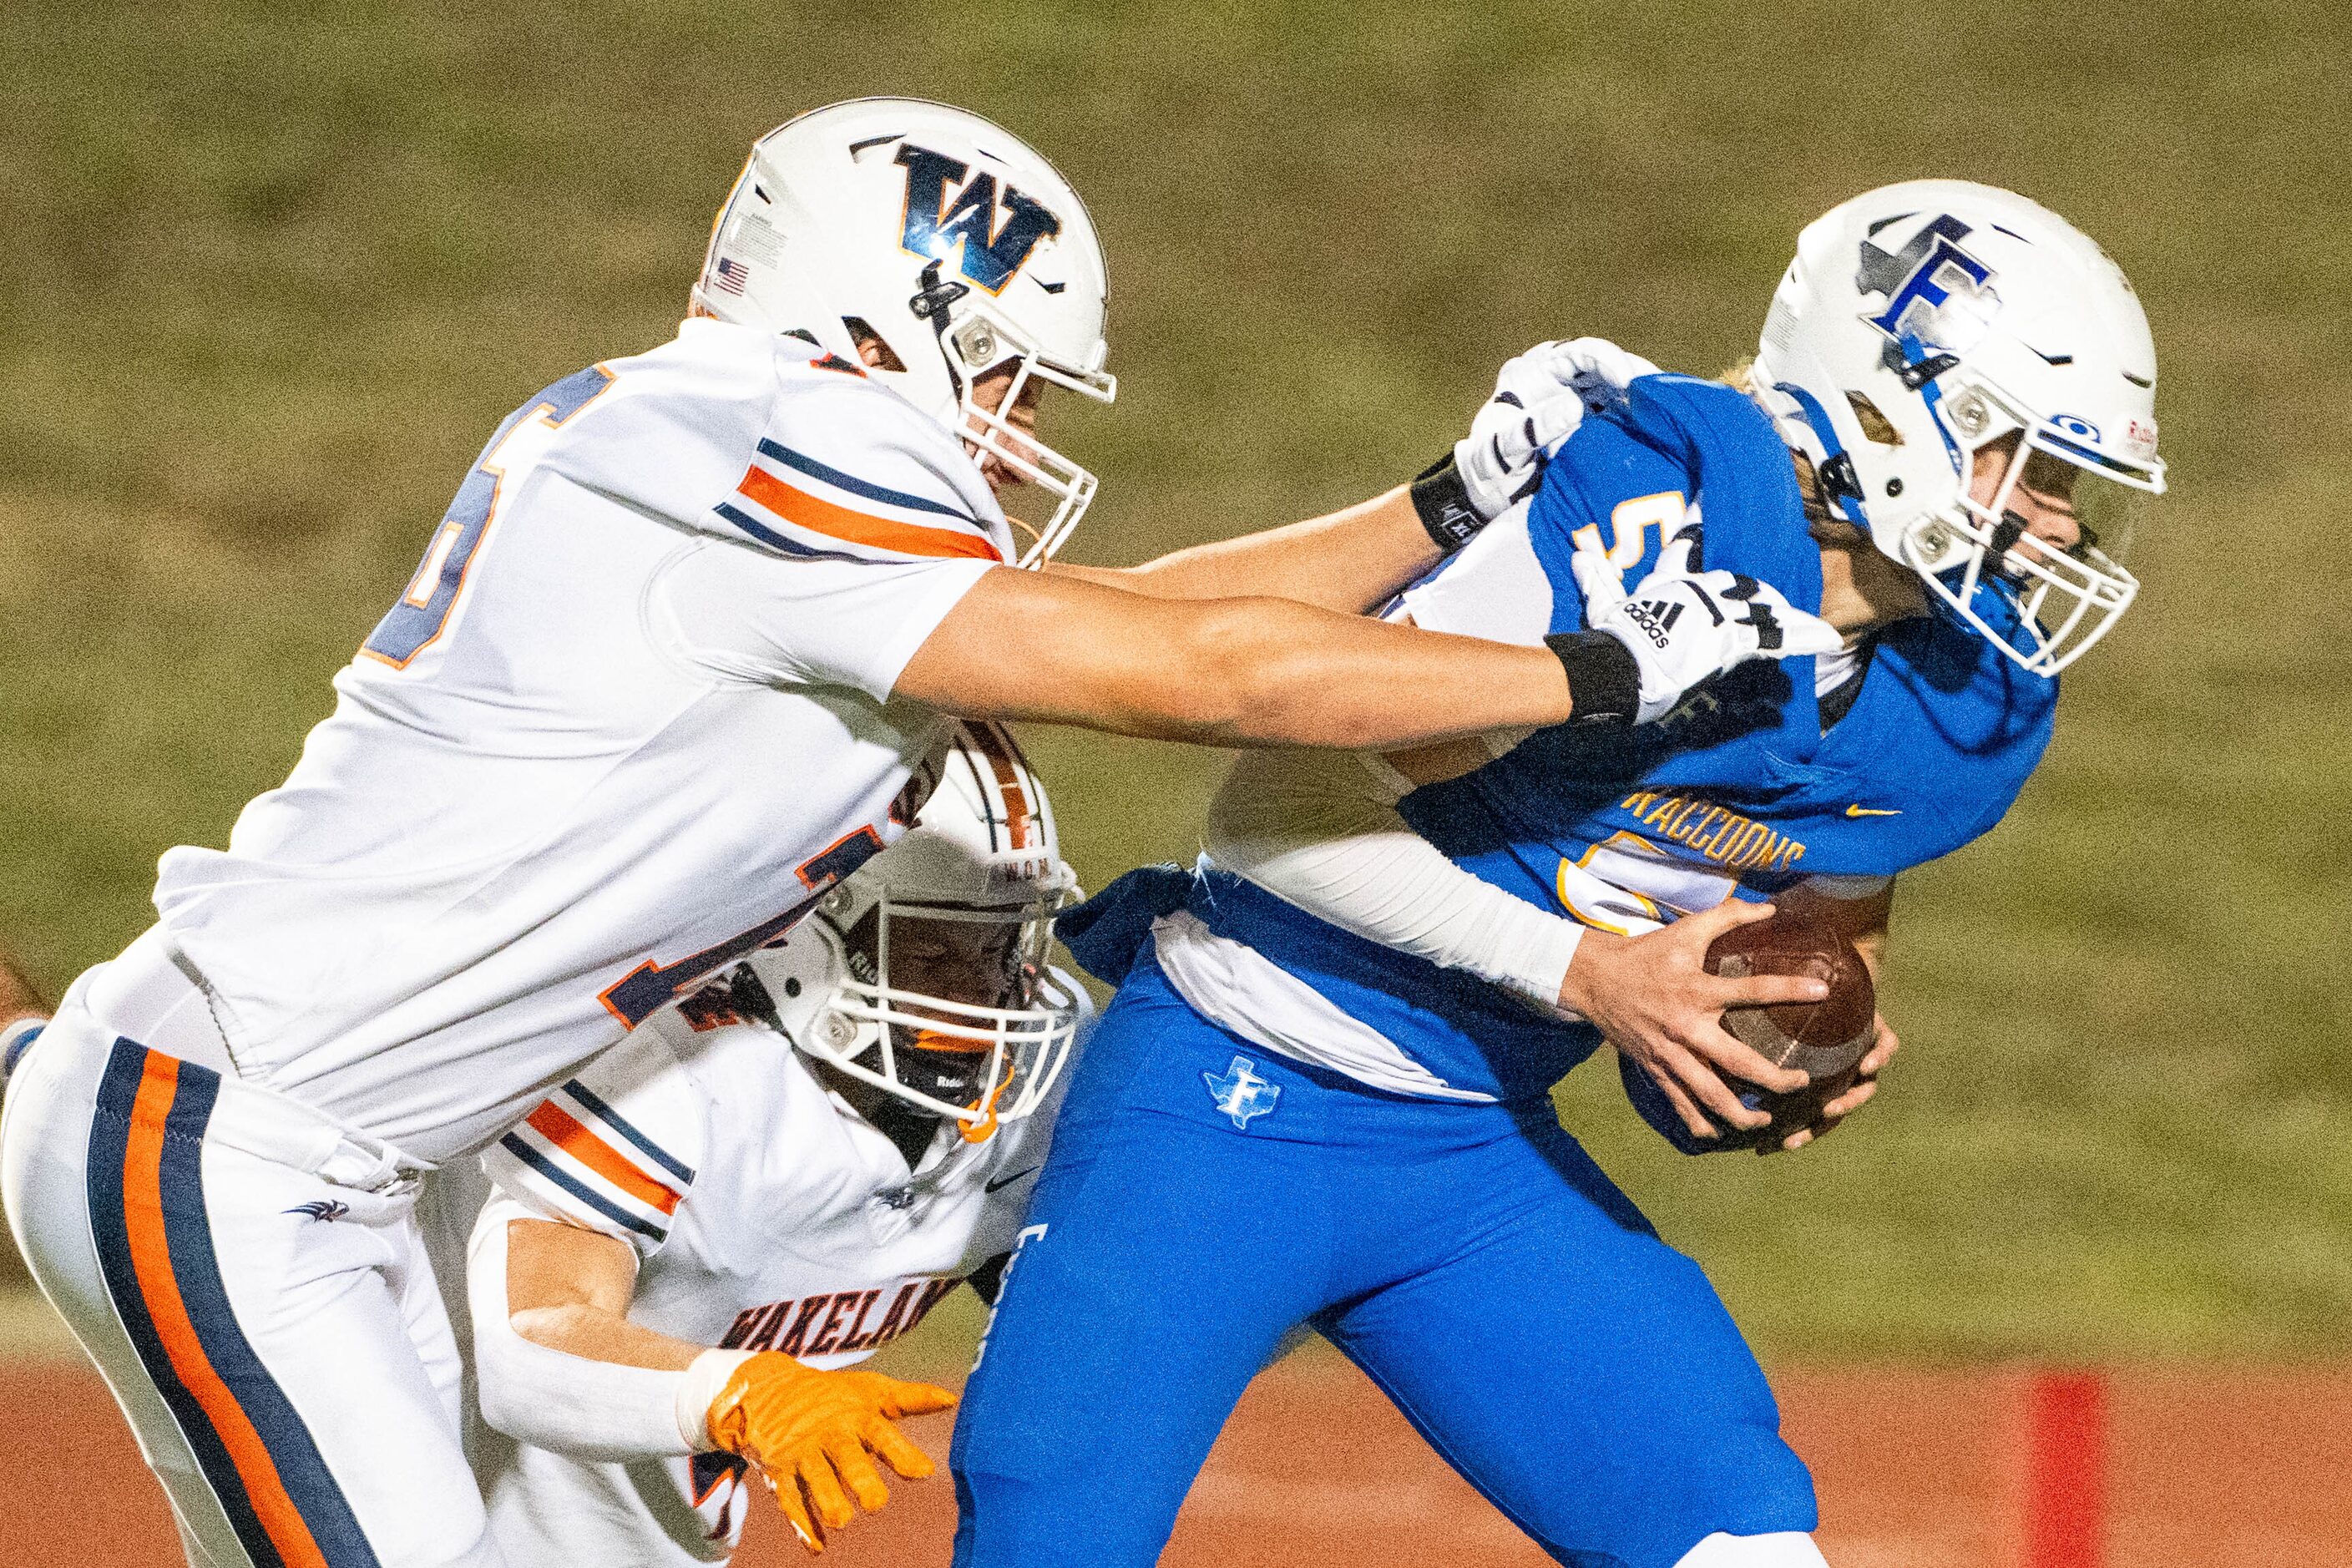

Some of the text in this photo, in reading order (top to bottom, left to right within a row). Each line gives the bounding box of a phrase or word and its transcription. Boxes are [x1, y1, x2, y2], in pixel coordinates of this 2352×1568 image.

[893, 143, 1062, 297] W
[1858, 232, 1997, 344] F
[1623, 603, 1669, 649] adidas
[1216, 1067, 1269, 1117] F
